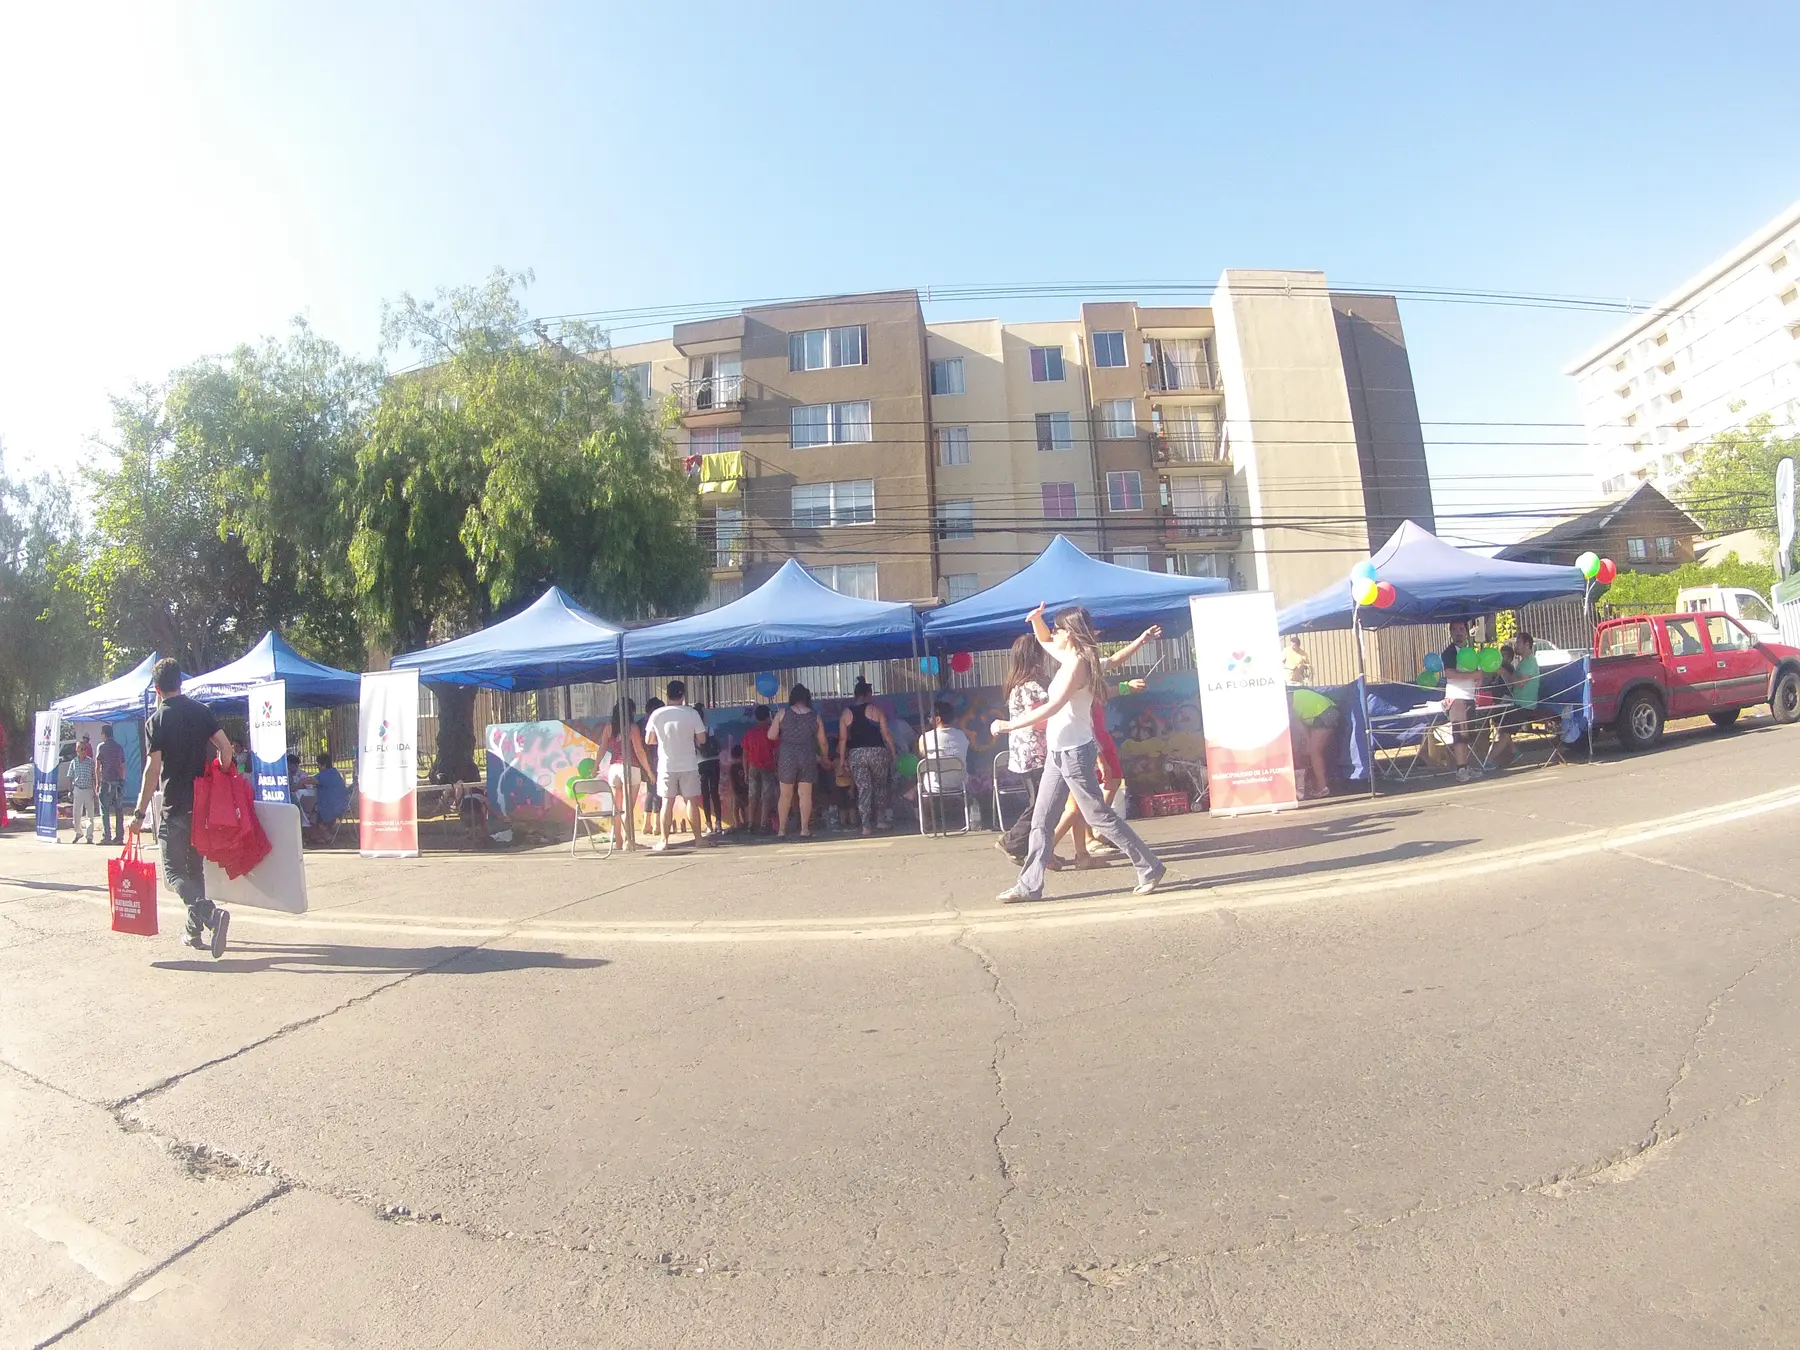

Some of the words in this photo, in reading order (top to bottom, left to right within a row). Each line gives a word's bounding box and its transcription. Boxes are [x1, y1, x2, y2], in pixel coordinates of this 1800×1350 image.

[1207, 681, 1223, 691] LA
[1226, 677, 1275, 689] FLORIDA
[376, 743, 411, 752] FLIDA
[277, 775, 288, 786] DE
